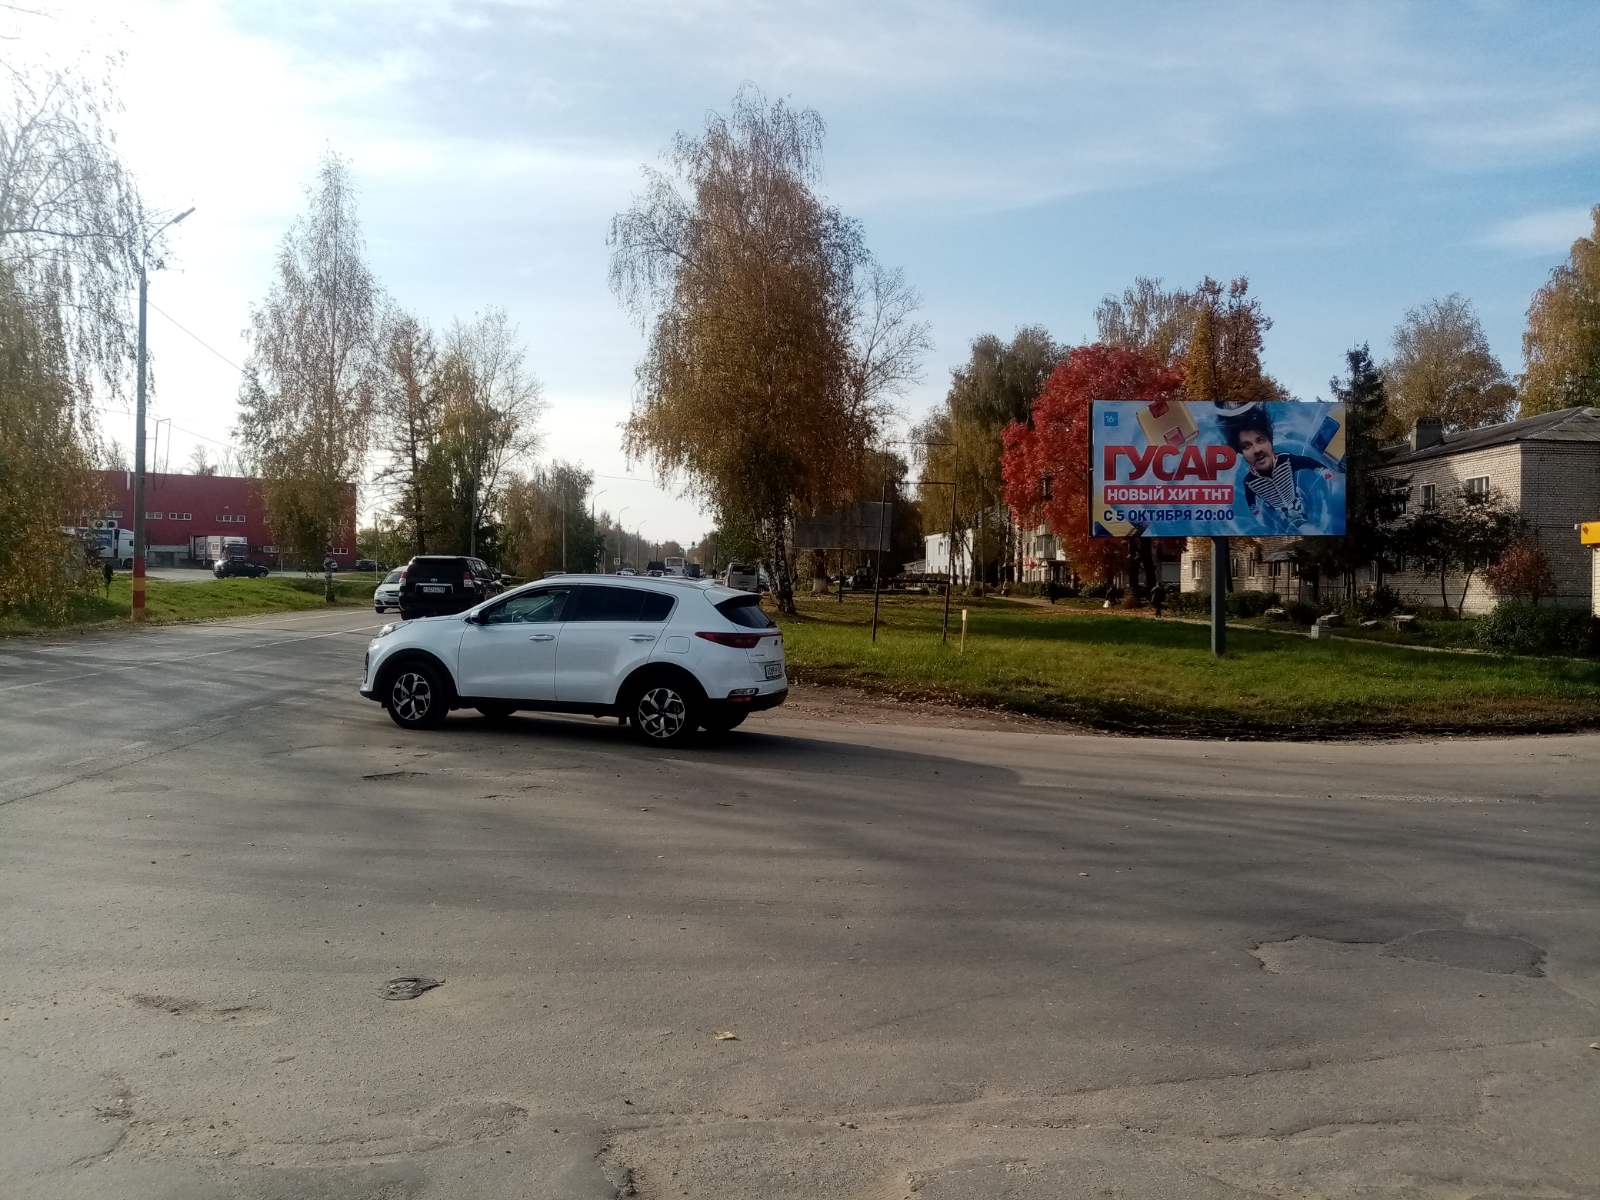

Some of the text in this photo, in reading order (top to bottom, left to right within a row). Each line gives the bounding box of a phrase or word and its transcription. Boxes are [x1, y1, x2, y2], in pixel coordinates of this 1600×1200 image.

[1104, 445, 1237, 481] ГУСАР
[1107, 485, 1231, 501] НОВЫЙ ХИТ ТНТ
[1104, 509, 1234, 521] С 5 ОКТЯБРЯ 20:00
